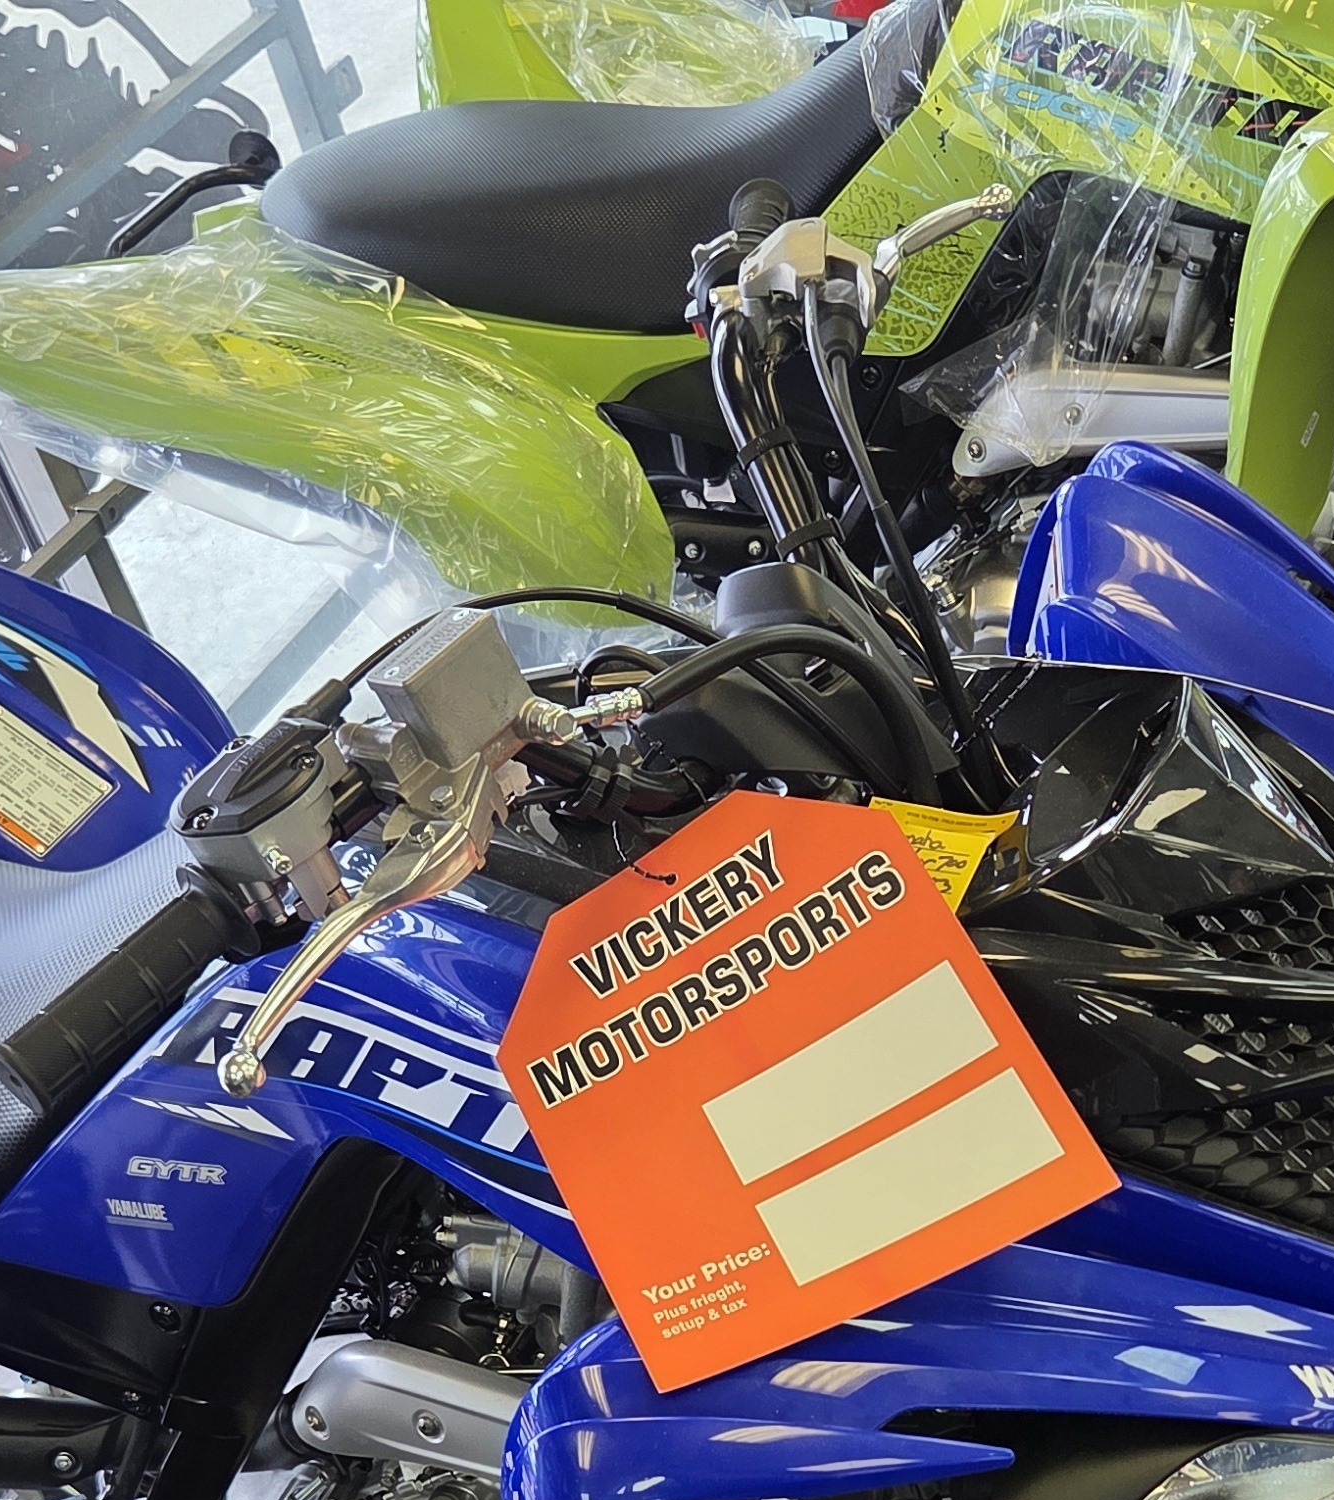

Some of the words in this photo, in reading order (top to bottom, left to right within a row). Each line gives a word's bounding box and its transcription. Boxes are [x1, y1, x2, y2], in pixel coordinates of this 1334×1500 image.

[1002, 19, 1323, 150] RAPTO
[570, 829, 784, 999] VICKERY
[527, 851, 905, 1109] MOTORSPORTS
[127, 1156, 227, 1185] GYTR
[106, 1198, 168, 1222] YAMALUBE
[641, 1274, 696, 1304] Your
[700, 1243, 771, 1282] Price:
[653, 1304, 688, 1325] Plus
[662, 1315, 705, 1339] setup
[708, 1308, 720, 1321] &
[722, 1298, 748, 1315] tax
